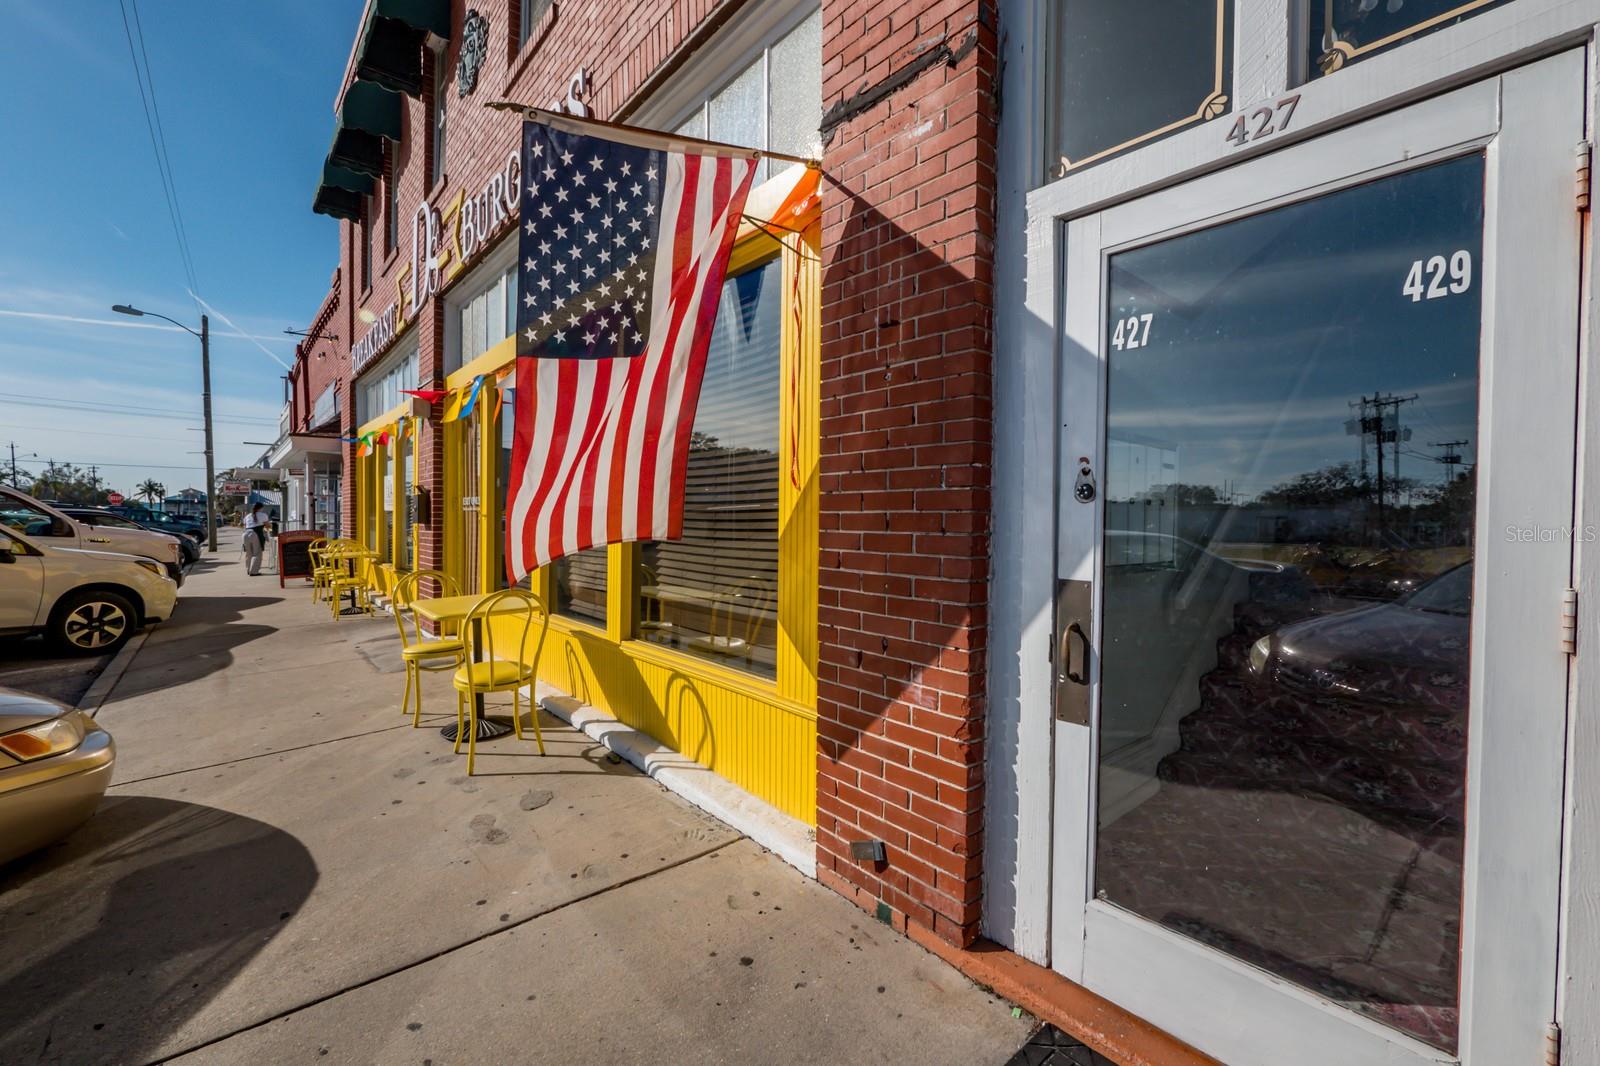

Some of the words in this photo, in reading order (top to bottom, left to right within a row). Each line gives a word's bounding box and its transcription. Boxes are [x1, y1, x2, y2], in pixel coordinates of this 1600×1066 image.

[1225, 94, 1301, 147] 427
[352, 302, 396, 375] BREAKFAST
[461, 66, 587, 263] BURGS
[1402, 249, 1471, 302] 429
[1111, 312, 1153, 351] 427
